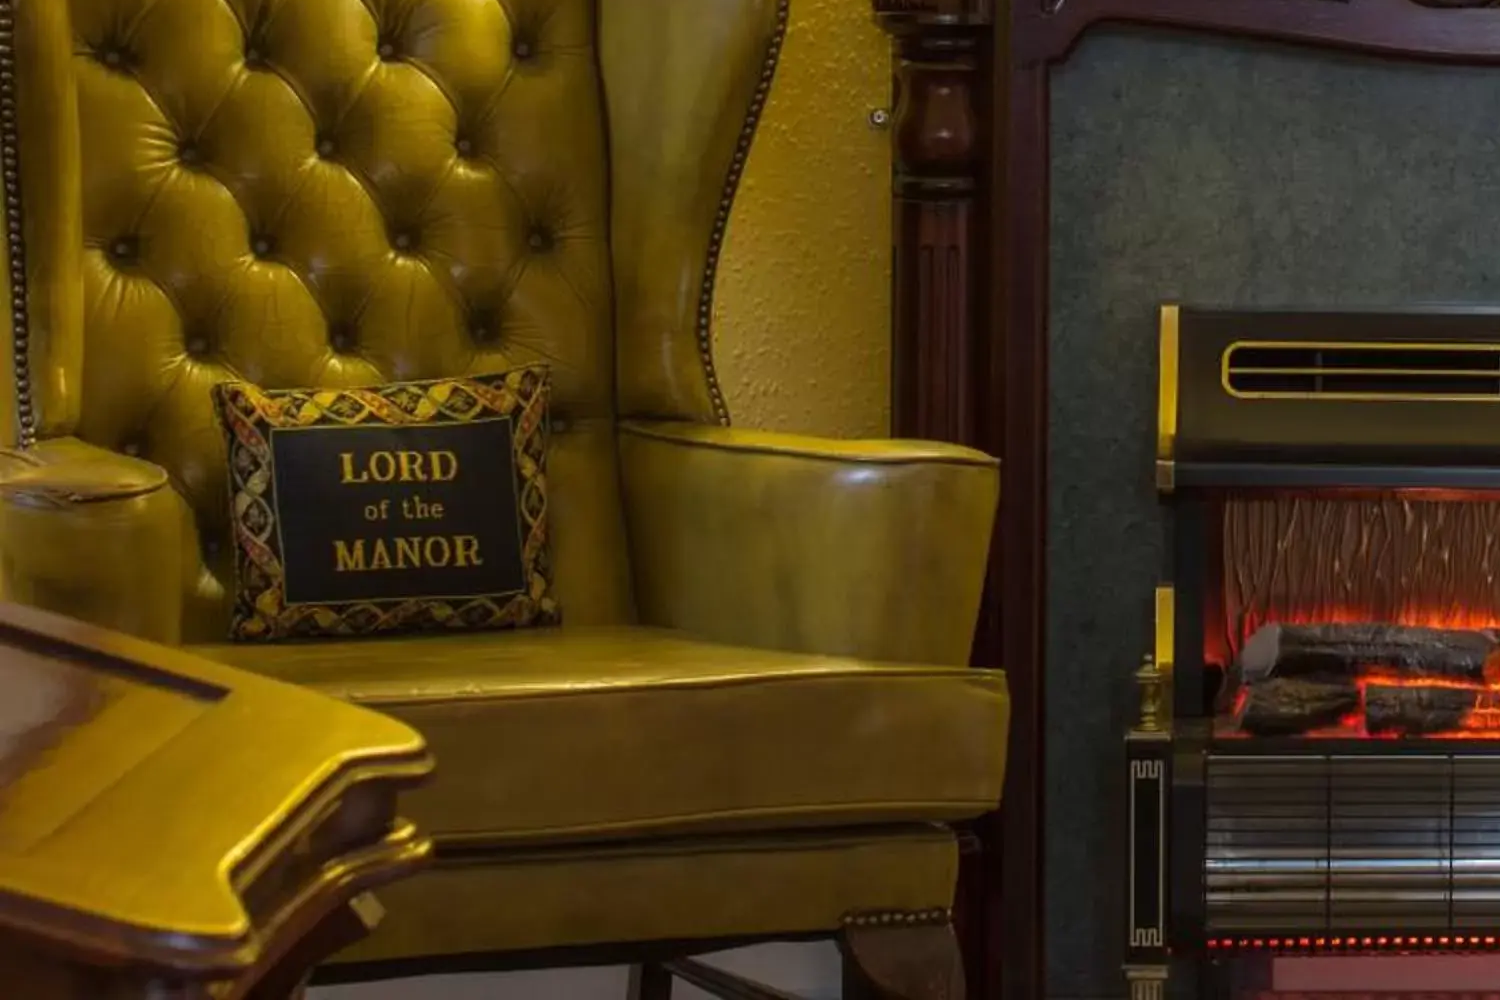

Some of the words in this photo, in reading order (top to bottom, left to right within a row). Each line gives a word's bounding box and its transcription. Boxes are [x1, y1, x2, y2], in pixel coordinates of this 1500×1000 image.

[340, 451, 458, 483] LORD
[364, 499, 390, 521] of
[402, 495, 445, 519] the
[334, 536, 482, 571] MANOR
